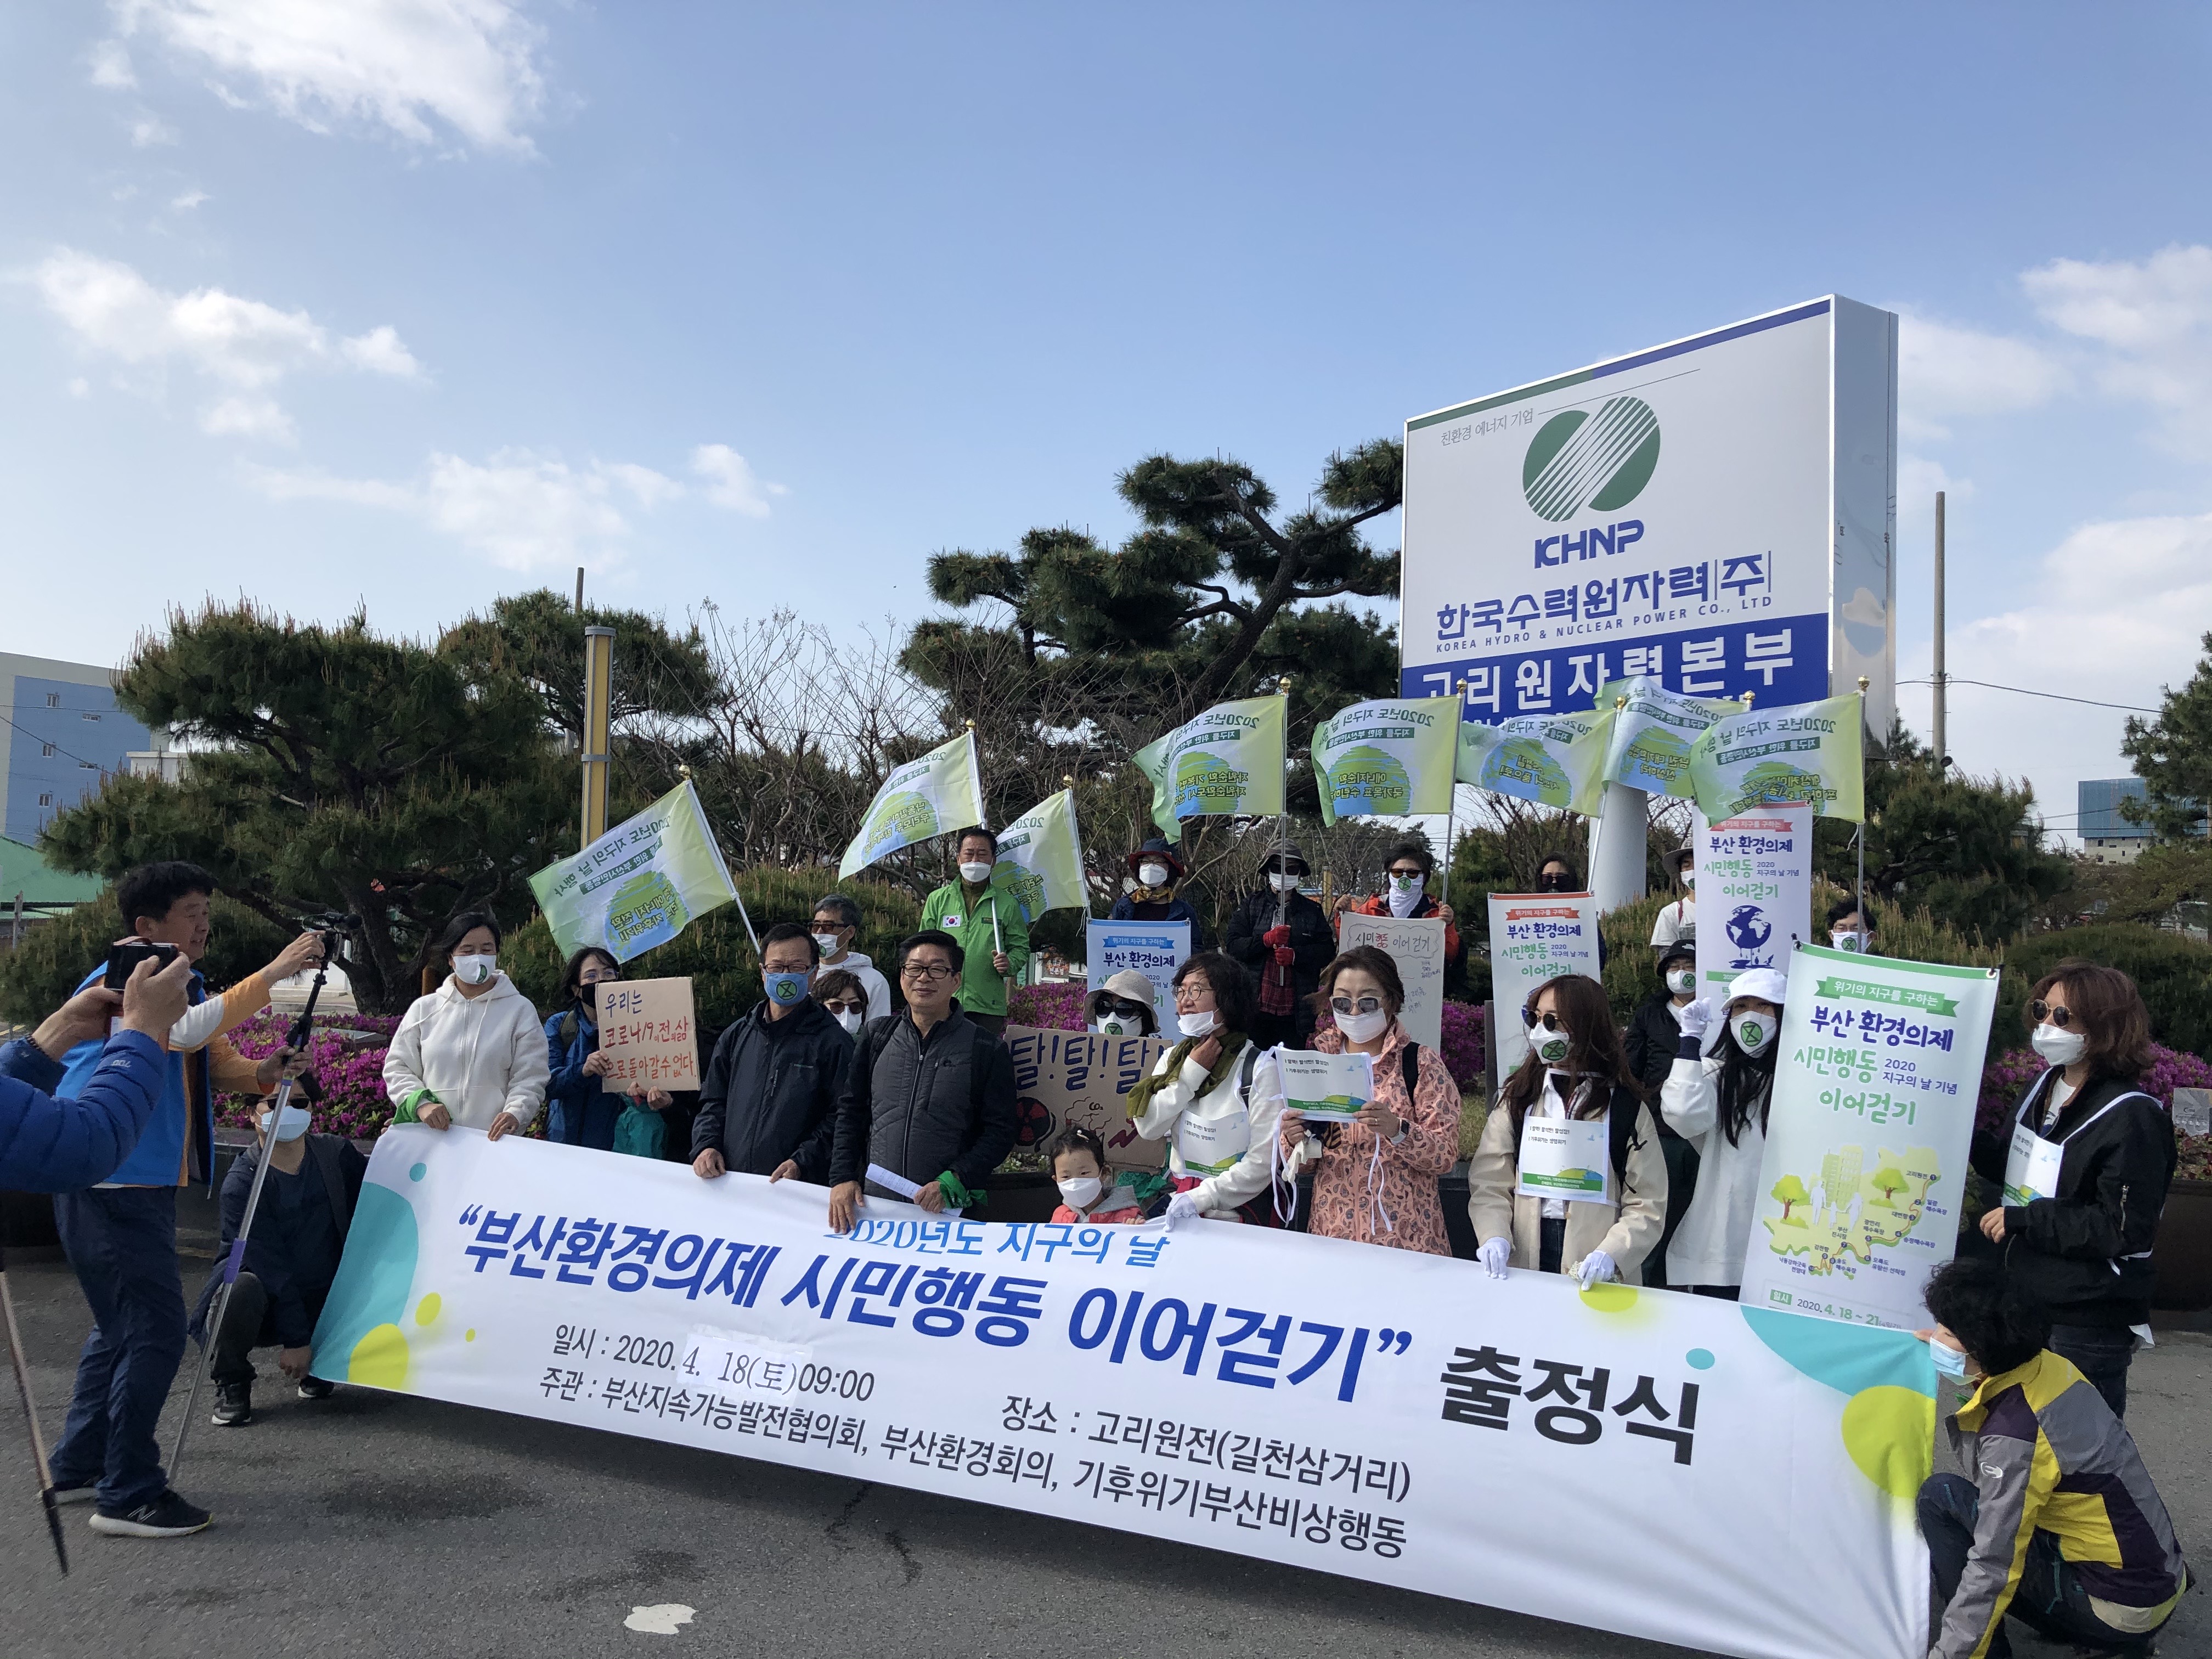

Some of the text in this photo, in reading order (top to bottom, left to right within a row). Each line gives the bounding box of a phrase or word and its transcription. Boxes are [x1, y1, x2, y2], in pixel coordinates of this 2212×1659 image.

[1441, 408, 1533, 446] 친환경 에너지 기업
[1534, 520, 1645, 569] KHNP
[1436, 639, 1477, 653] KOREA
[1485, 631, 1530, 647] HYDRO
[1539, 630, 1547, 639] &
[1556, 619, 1623, 637] NUCLEAR
[1633, 608, 1688, 626] POWER
[1742, 596, 1772, 609] LTD
[1709, 835, 1793, 855] 부산 환경의제
[1703, 859, 1753, 878] 시민행동
[1722, 882, 1779, 900] 이어걷기
[1507, 922, 1581, 939] 부산 환경의제
[1103, 951, 1175, 968] 부산 환경의제
[1502, 942, 1548, 960] 시민행동
[1521, 962, 1572, 978] 이어걷기
[605, 990, 642, 1018] 우리는
[1833, 981, 1938, 1007] 위기의 지구를 구하는
[1810, 1006, 1954, 1052] 부산 환경의제
[1793, 1046, 1878, 1084] 시민행동
[1884, 1059, 1916, 1072] 2020
[1882, 1072, 1957, 1095] 지구의 날 기념
[1819, 1088, 1916, 1125] 이어걷기
[997, 1223, 1115, 1263] 지구의
[1126, 1234, 1170, 1268] 날
[1774, 1291, 1788, 1304] 일시
[1797, 1298, 1822, 1313] 2020.
[1824, 1304, 1836, 1316] 4.
[1839, 1307, 1853, 1320] 18
[458, 1204, 1700, 1466] “부산환경의제 시민행동 이어걷기” 출정식
[553, 1324, 596, 1359] 일시
[540, 1367, 584, 1402] 주관
[601, 1376, 868, 1457] 부산지속가능발전협의회,
[881, 1425, 1059, 1492] 부산환경회의,
[1073, 1459, 1407, 1559] 기후위기부산비상행동
[1002, 1395, 1058, 1434] 장소
[1088, 1410, 1412, 1503] 고리원전(길천삼거리)
